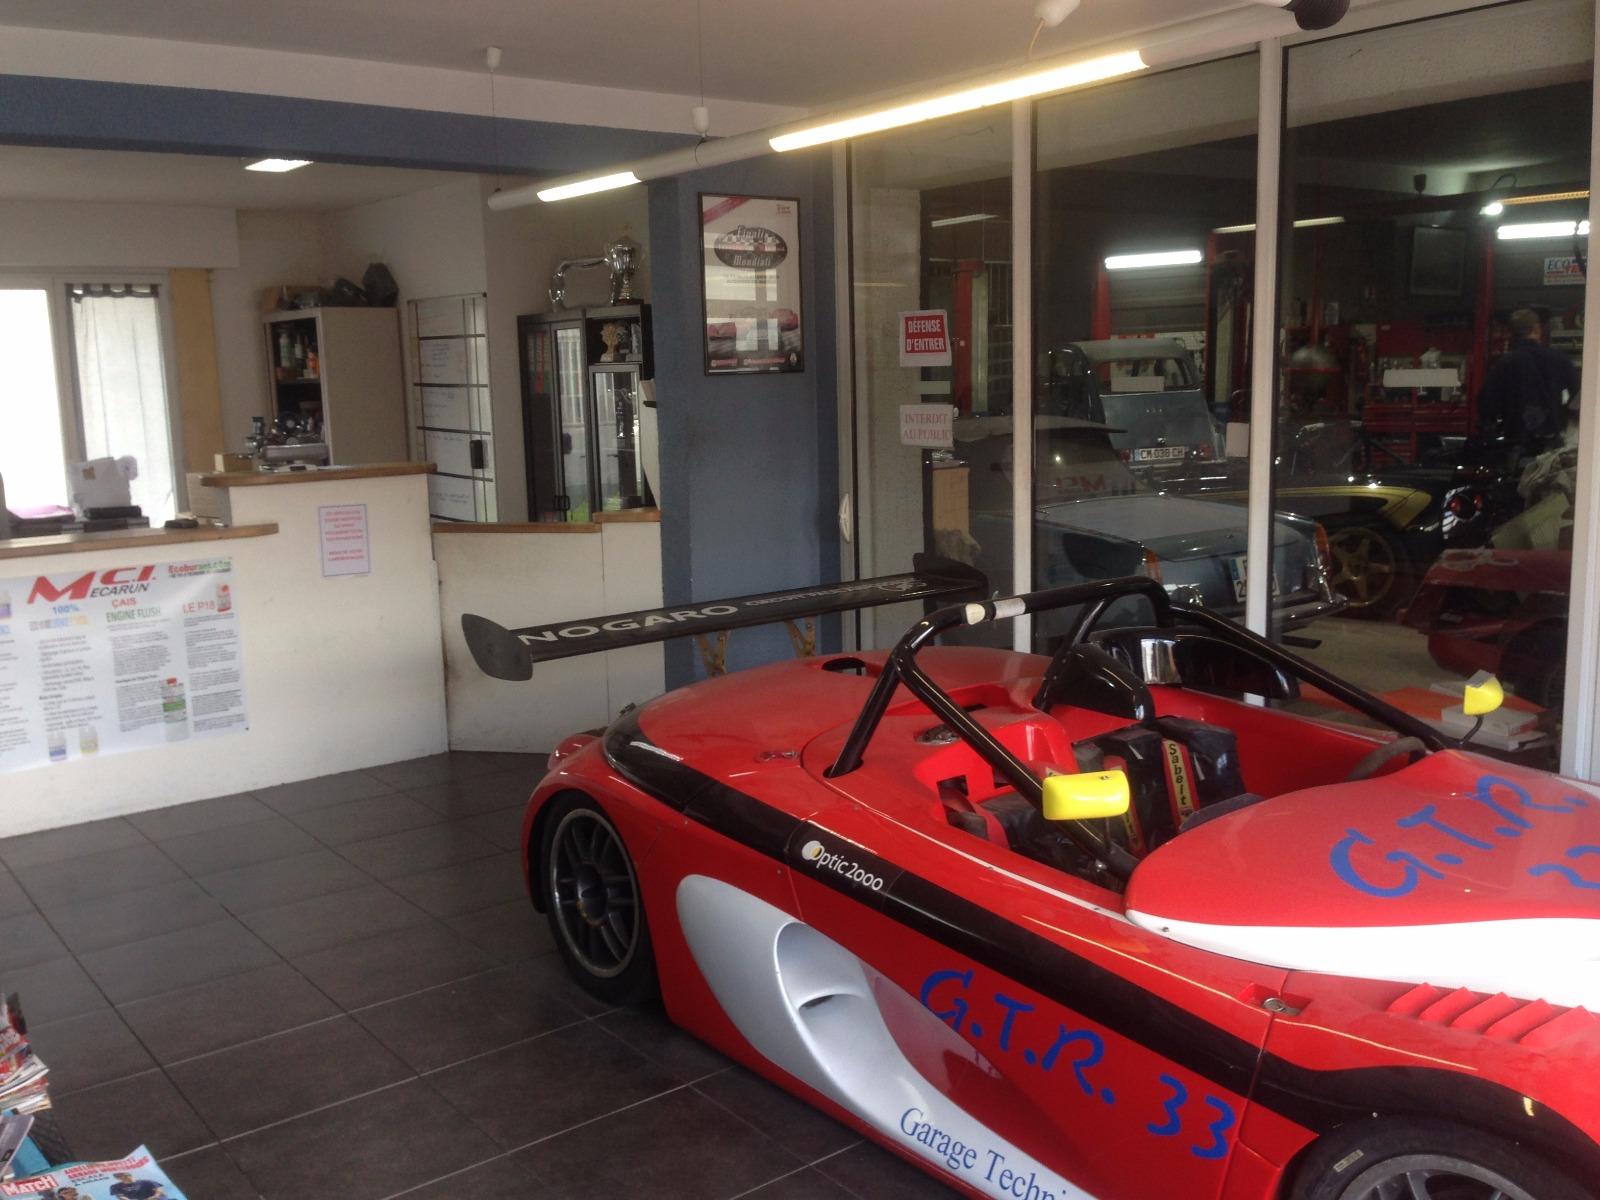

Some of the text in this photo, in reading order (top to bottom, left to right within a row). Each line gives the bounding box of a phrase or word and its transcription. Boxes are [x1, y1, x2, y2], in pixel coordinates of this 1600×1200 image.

[907, 338, 945, 351] D'ENTRER
[517, 605, 739, 646] NOGARO
[1167, 743, 1188, 806] Sabelt
[920, 969, 1236, 1160] G.T.R. 33
[900, 1107, 978, 1171] Garage
